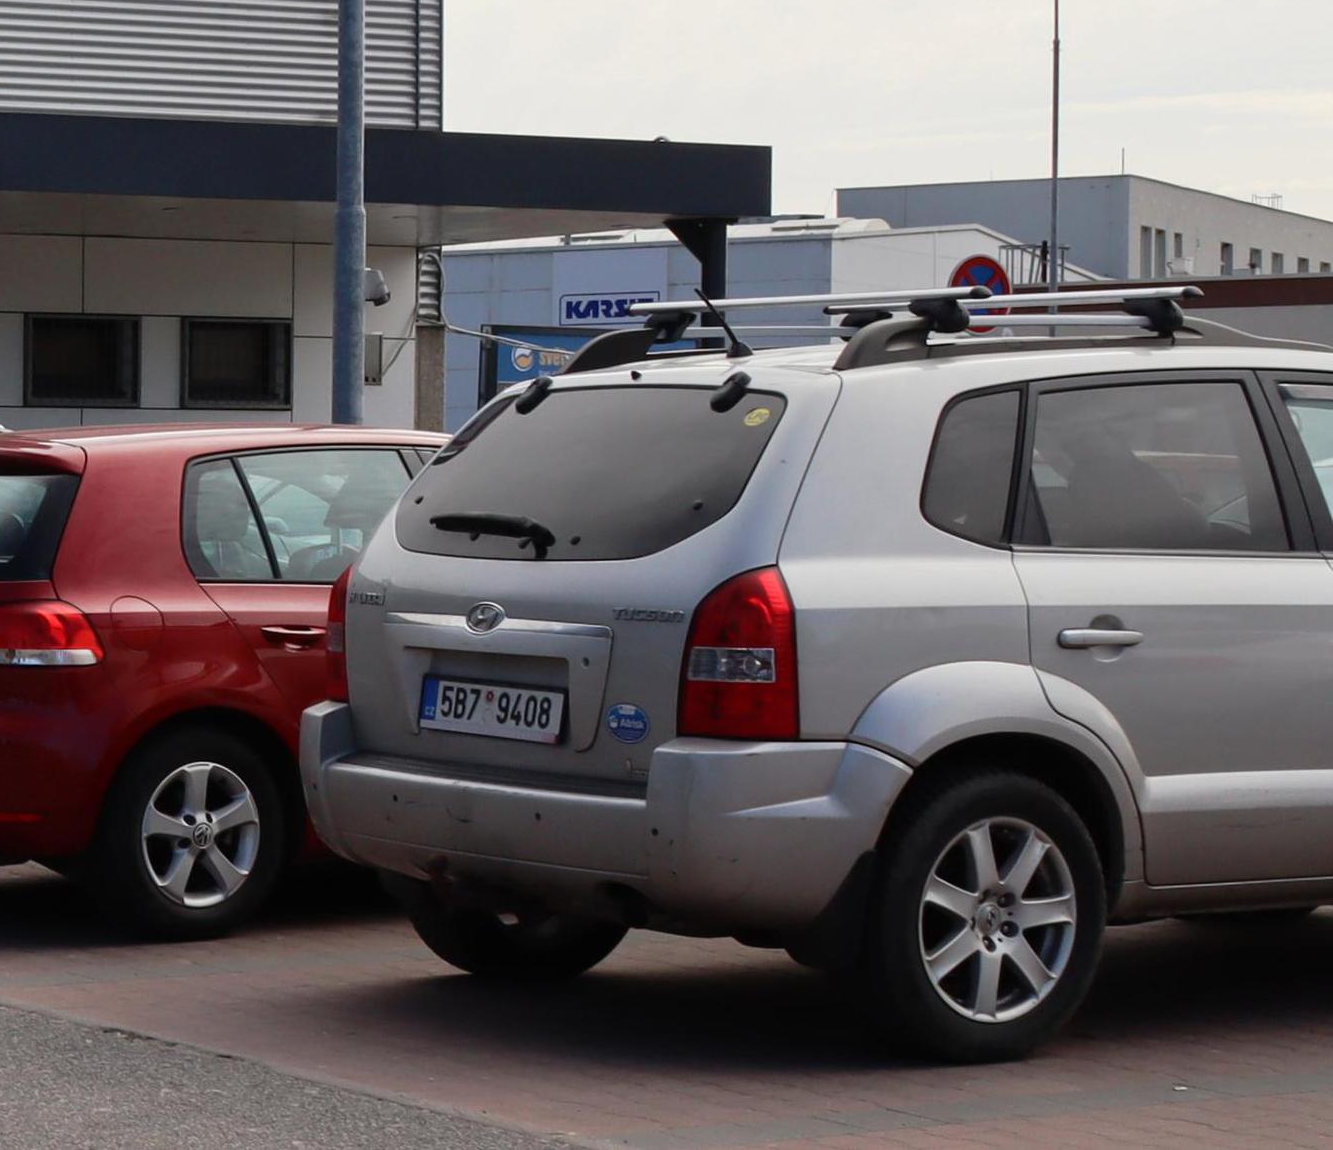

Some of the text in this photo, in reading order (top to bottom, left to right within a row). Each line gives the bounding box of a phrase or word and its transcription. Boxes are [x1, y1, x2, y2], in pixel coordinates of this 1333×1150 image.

[565, 298, 654, 320] KARS
[613, 607, 685, 623] TUCSON
[440, 686, 481, 721] 5B7
[496, 692, 552, 729] 9408
